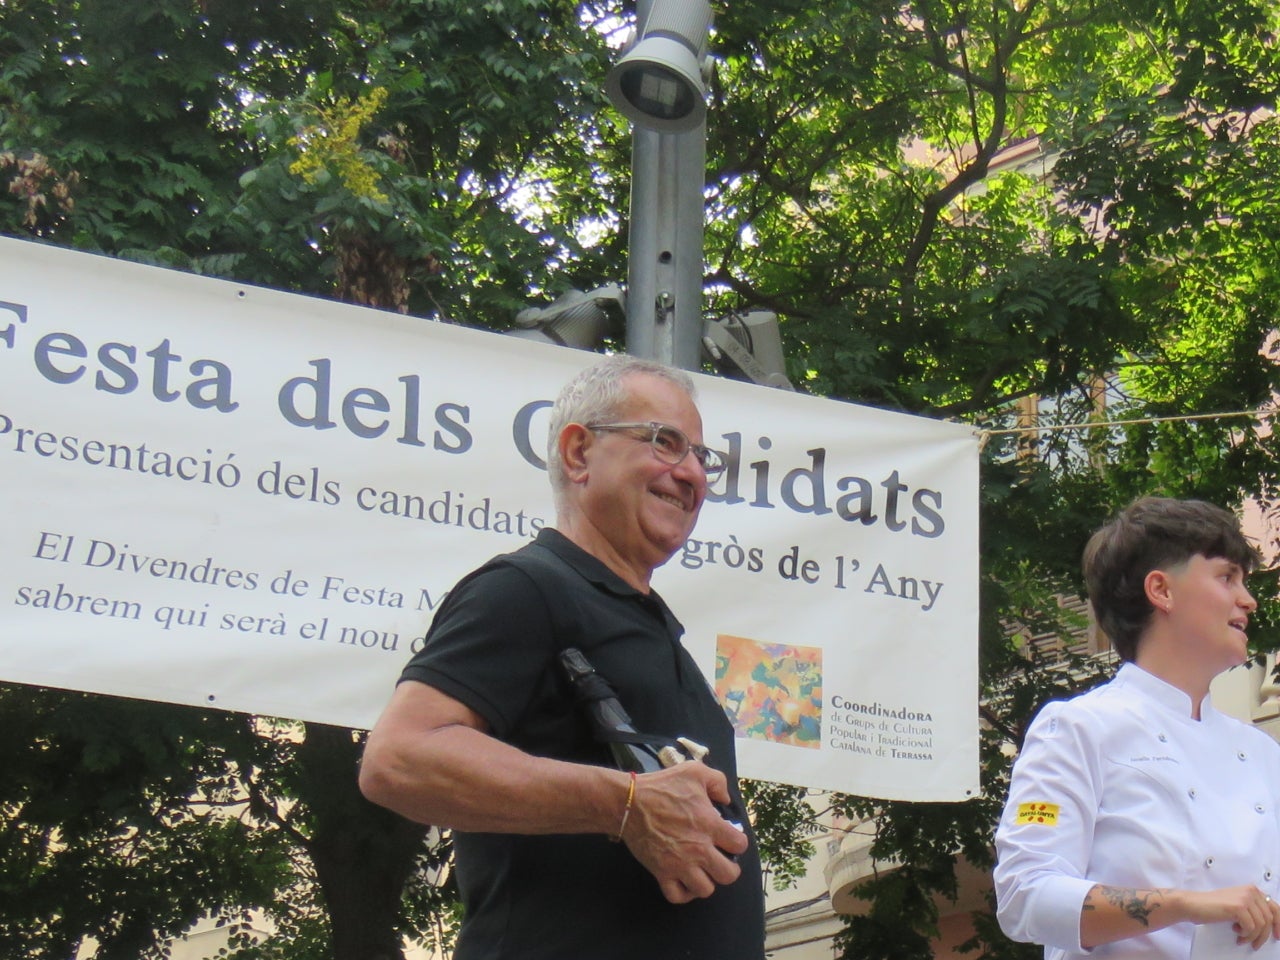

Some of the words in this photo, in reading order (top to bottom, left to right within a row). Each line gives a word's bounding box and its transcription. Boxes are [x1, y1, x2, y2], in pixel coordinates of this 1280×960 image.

[278, 358, 473, 455] dels
[32, 531, 75, 563] El
[83, 539, 259, 590] Divendres
[271, 568, 309, 597] de
[321, 576, 404, 608] Festa
[257, 460, 341, 506] dels
[680, 535, 764, 572] gròs
[778, 546, 820, 584] de
[834, 556, 943, 611] l'Any
[15, 582, 141, 620] sabrem
[154, 602, 210, 630] qui
[220, 613, 287, 636] serà
[299, 616, 328, 642] el
[339, 628, 399, 652] nou
